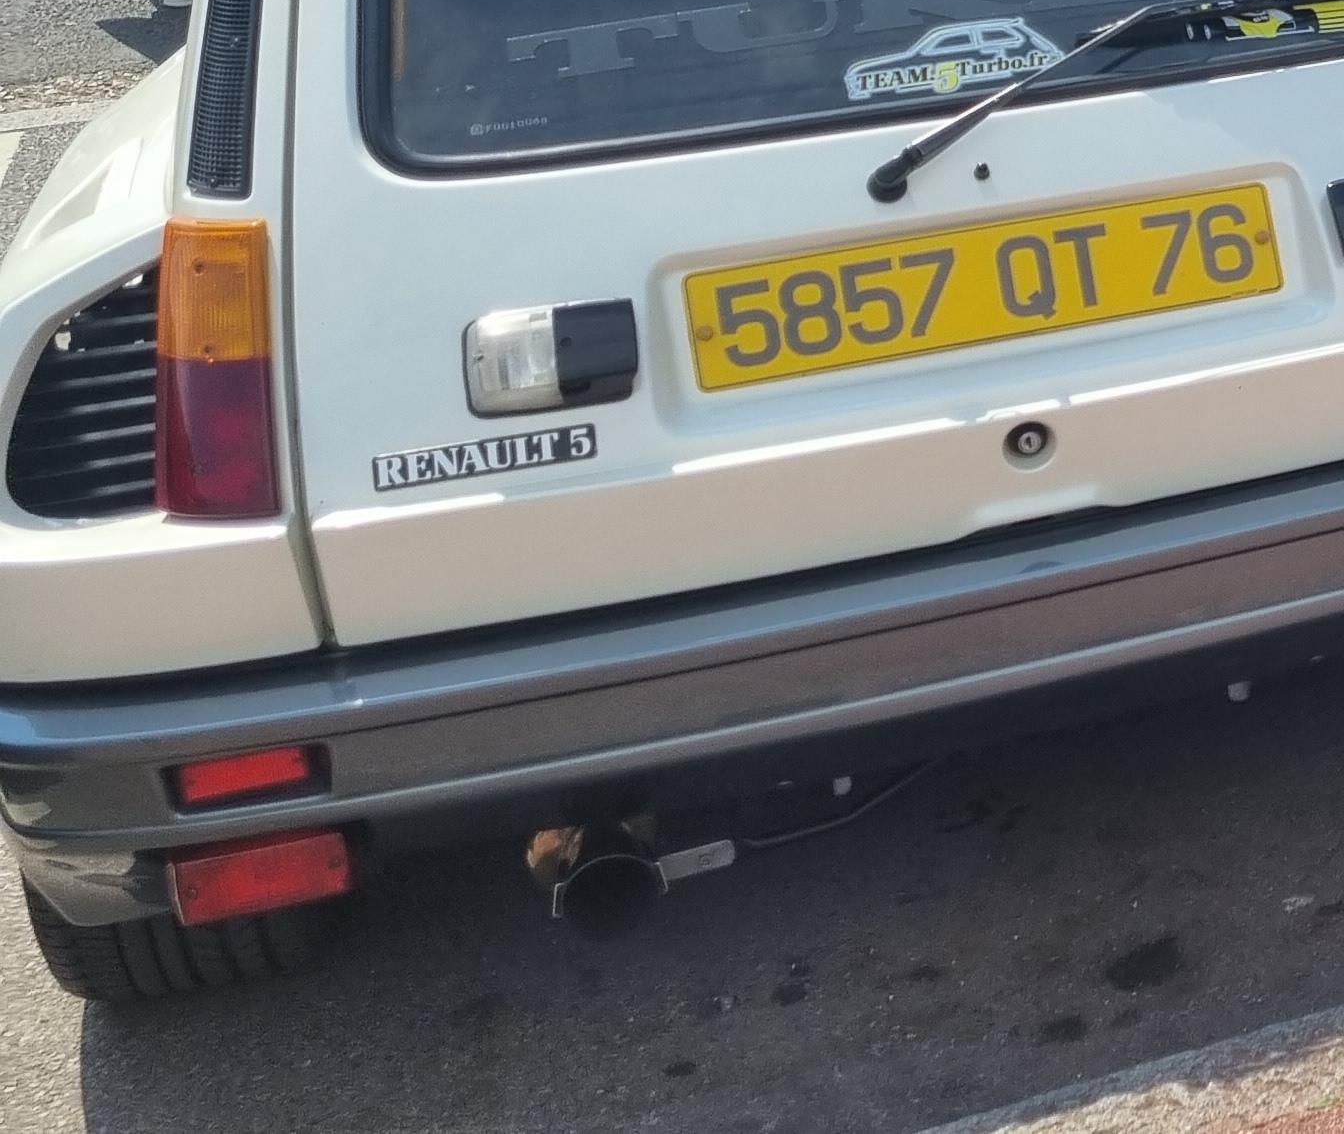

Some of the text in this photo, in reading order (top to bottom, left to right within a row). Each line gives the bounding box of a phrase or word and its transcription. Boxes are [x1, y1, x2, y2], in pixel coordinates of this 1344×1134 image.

[714, 202, 1255, 367] 5857 QT 76
[376, 427, 592, 488] RENAULT 5
